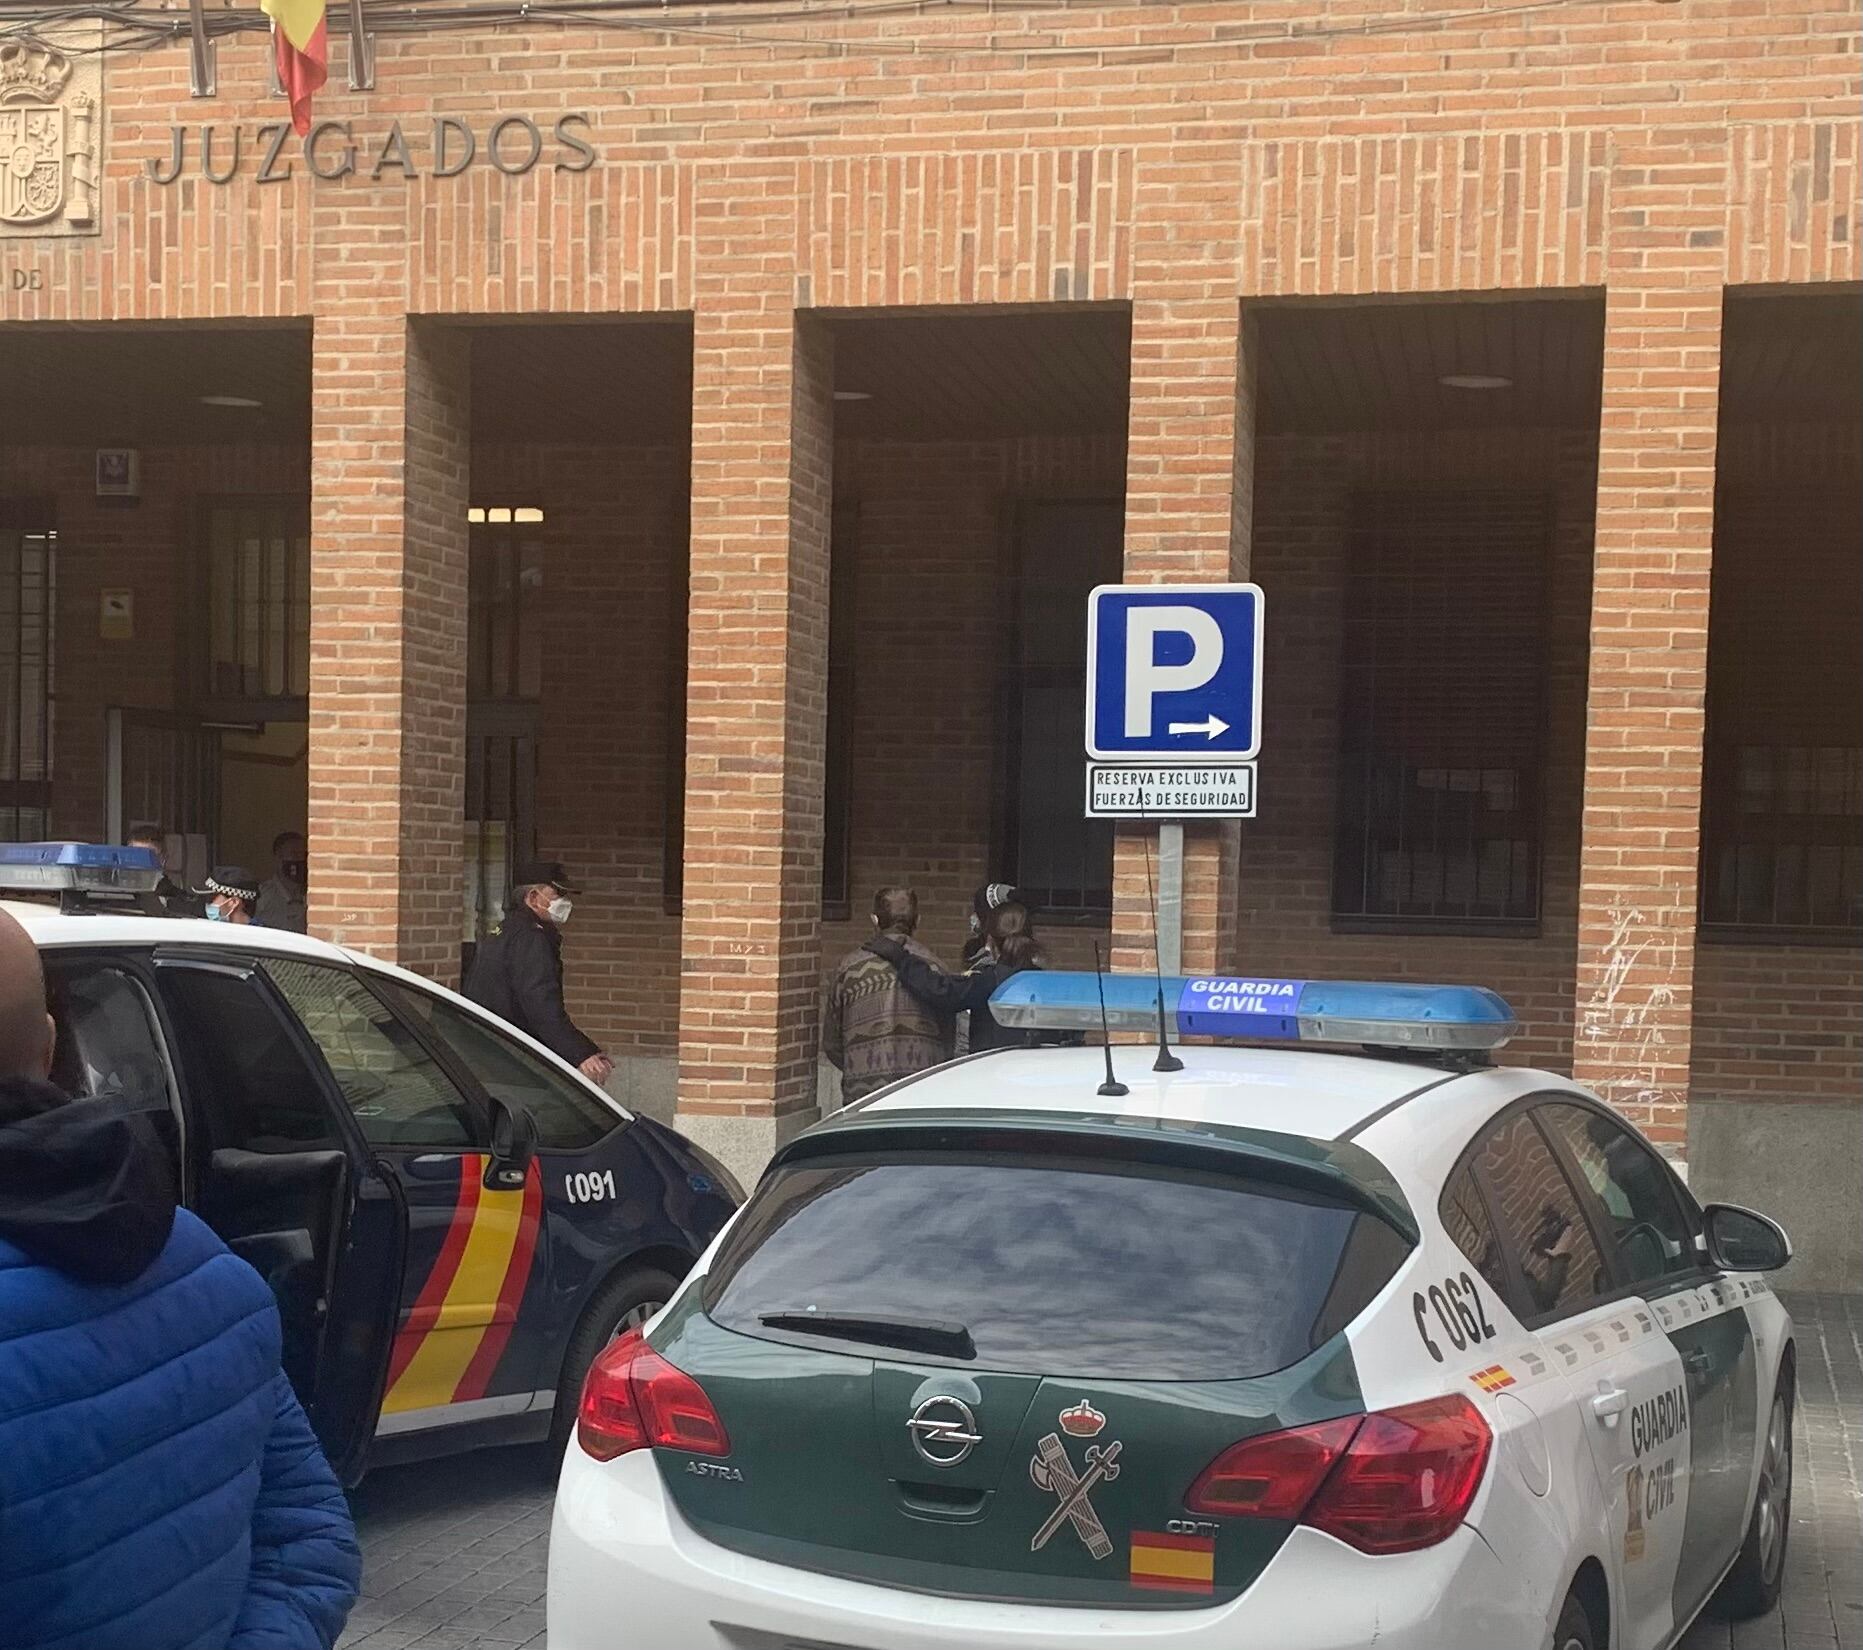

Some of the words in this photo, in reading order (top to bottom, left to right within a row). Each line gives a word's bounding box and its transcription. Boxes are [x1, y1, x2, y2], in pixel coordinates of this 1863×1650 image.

[146, 112, 597, 185] JUZGADOS
[13, 268, 44, 290] DE
[1124, 605, 1225, 739] P
[1097, 771, 1155, 786] RESERVA
[1159, 771, 1237, 786] EXCLUSIVA
[1095, 792, 1152, 807] FUERZAS
[1156, 792, 1171, 806] DE
[1174, 792, 1247, 806] SEGURIDAD
[1191, 980, 1294, 997] GUARDIA
[1207, 995, 1268, 1013] CIVIL
[574, 1169, 617, 1203] 091
[1428, 1271, 1497, 1352] 062
[1631, 1384, 1688, 1459] GUARDIA
[685, 1461, 744, 1482] ASTRA
[1646, 1457, 1675, 1521] CIVIL
